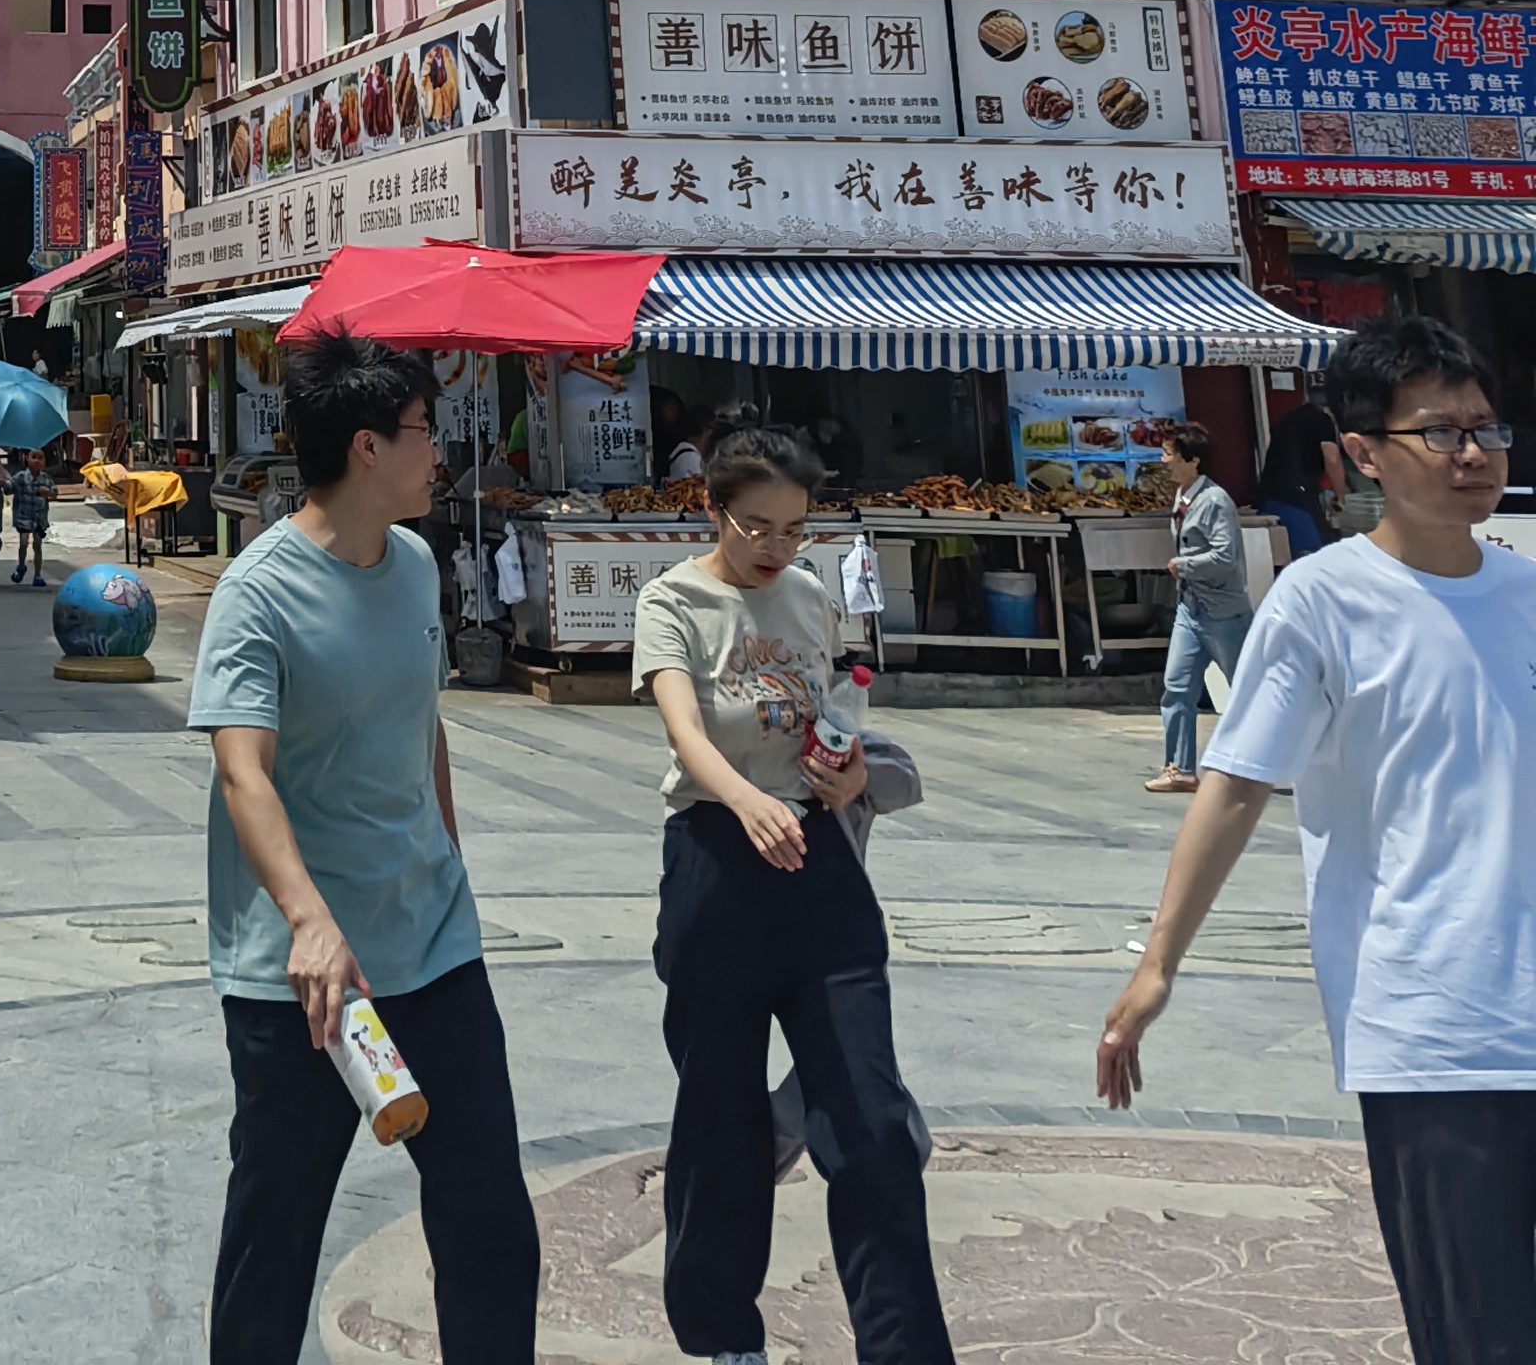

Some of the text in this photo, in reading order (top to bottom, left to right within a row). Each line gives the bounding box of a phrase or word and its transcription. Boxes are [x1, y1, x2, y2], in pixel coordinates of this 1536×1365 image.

[655, 17, 920, 70] 善味鱼饼
[1232, 6, 1536, 68] 炎亭水产海鲜
[1468, 73, 1522, 92] 黄鱼干
[258, 181, 345, 259] 善味鱼饼
